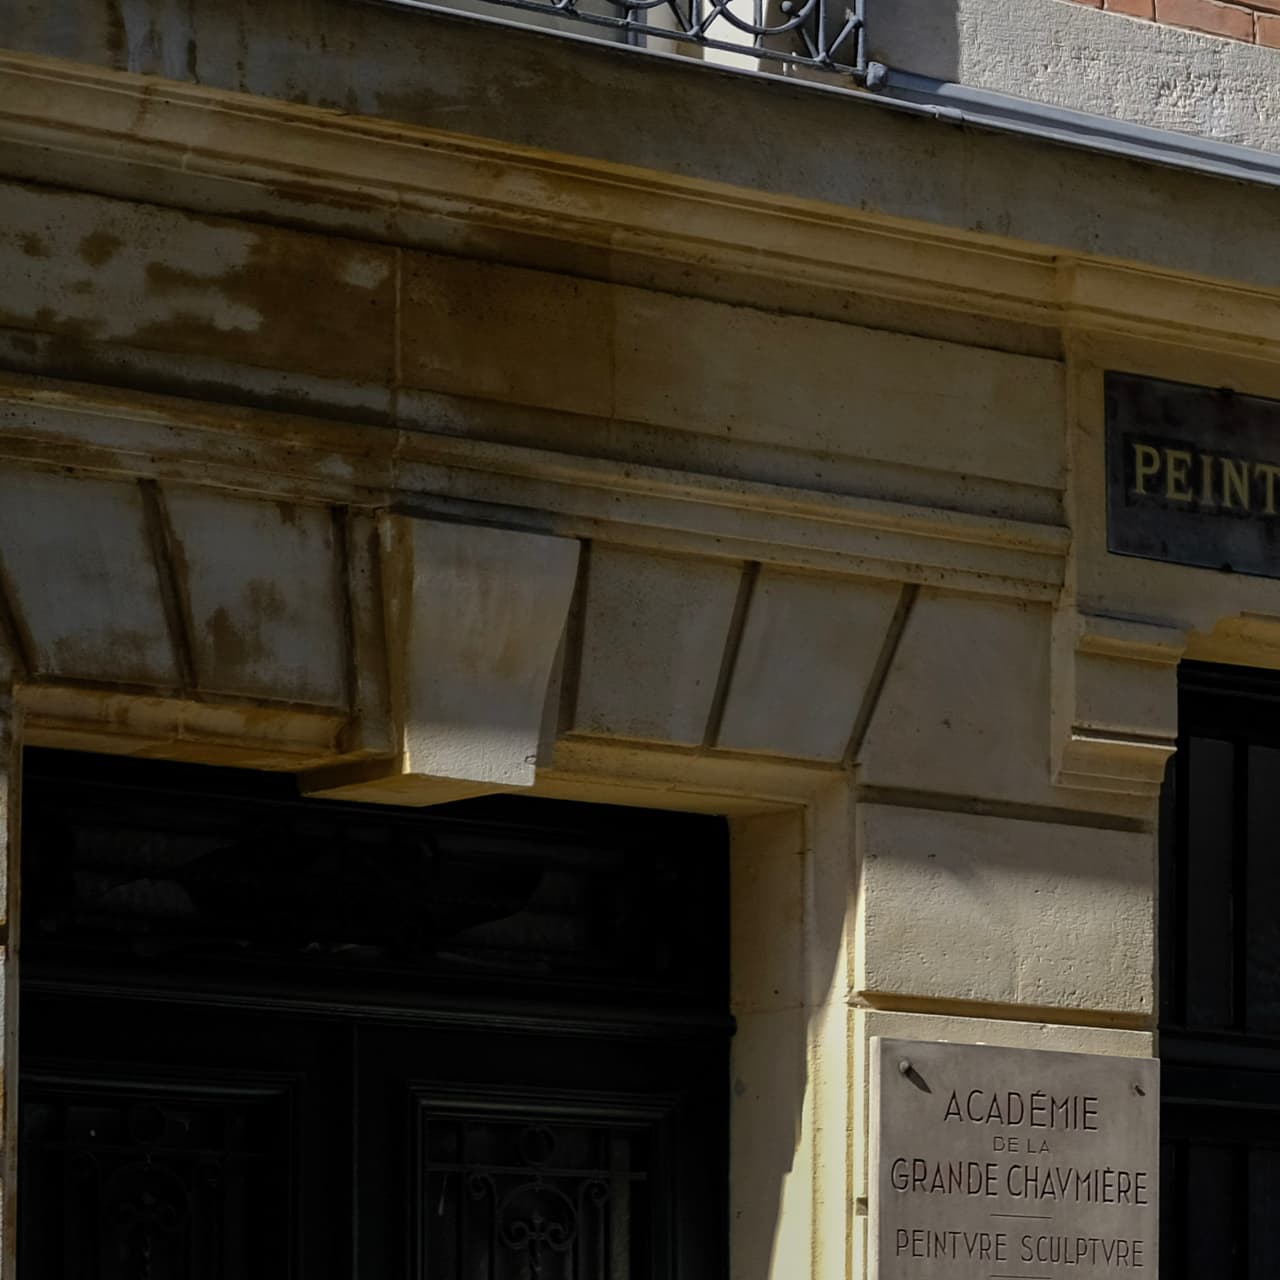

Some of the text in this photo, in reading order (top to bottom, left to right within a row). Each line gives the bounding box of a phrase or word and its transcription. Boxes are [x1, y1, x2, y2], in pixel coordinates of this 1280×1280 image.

[944, 1088, 1100, 1132] ACADÉMIE
[992, 1136, 1050, 1155] DE LA
[890, 1157, 999, 1197] GRANDE
